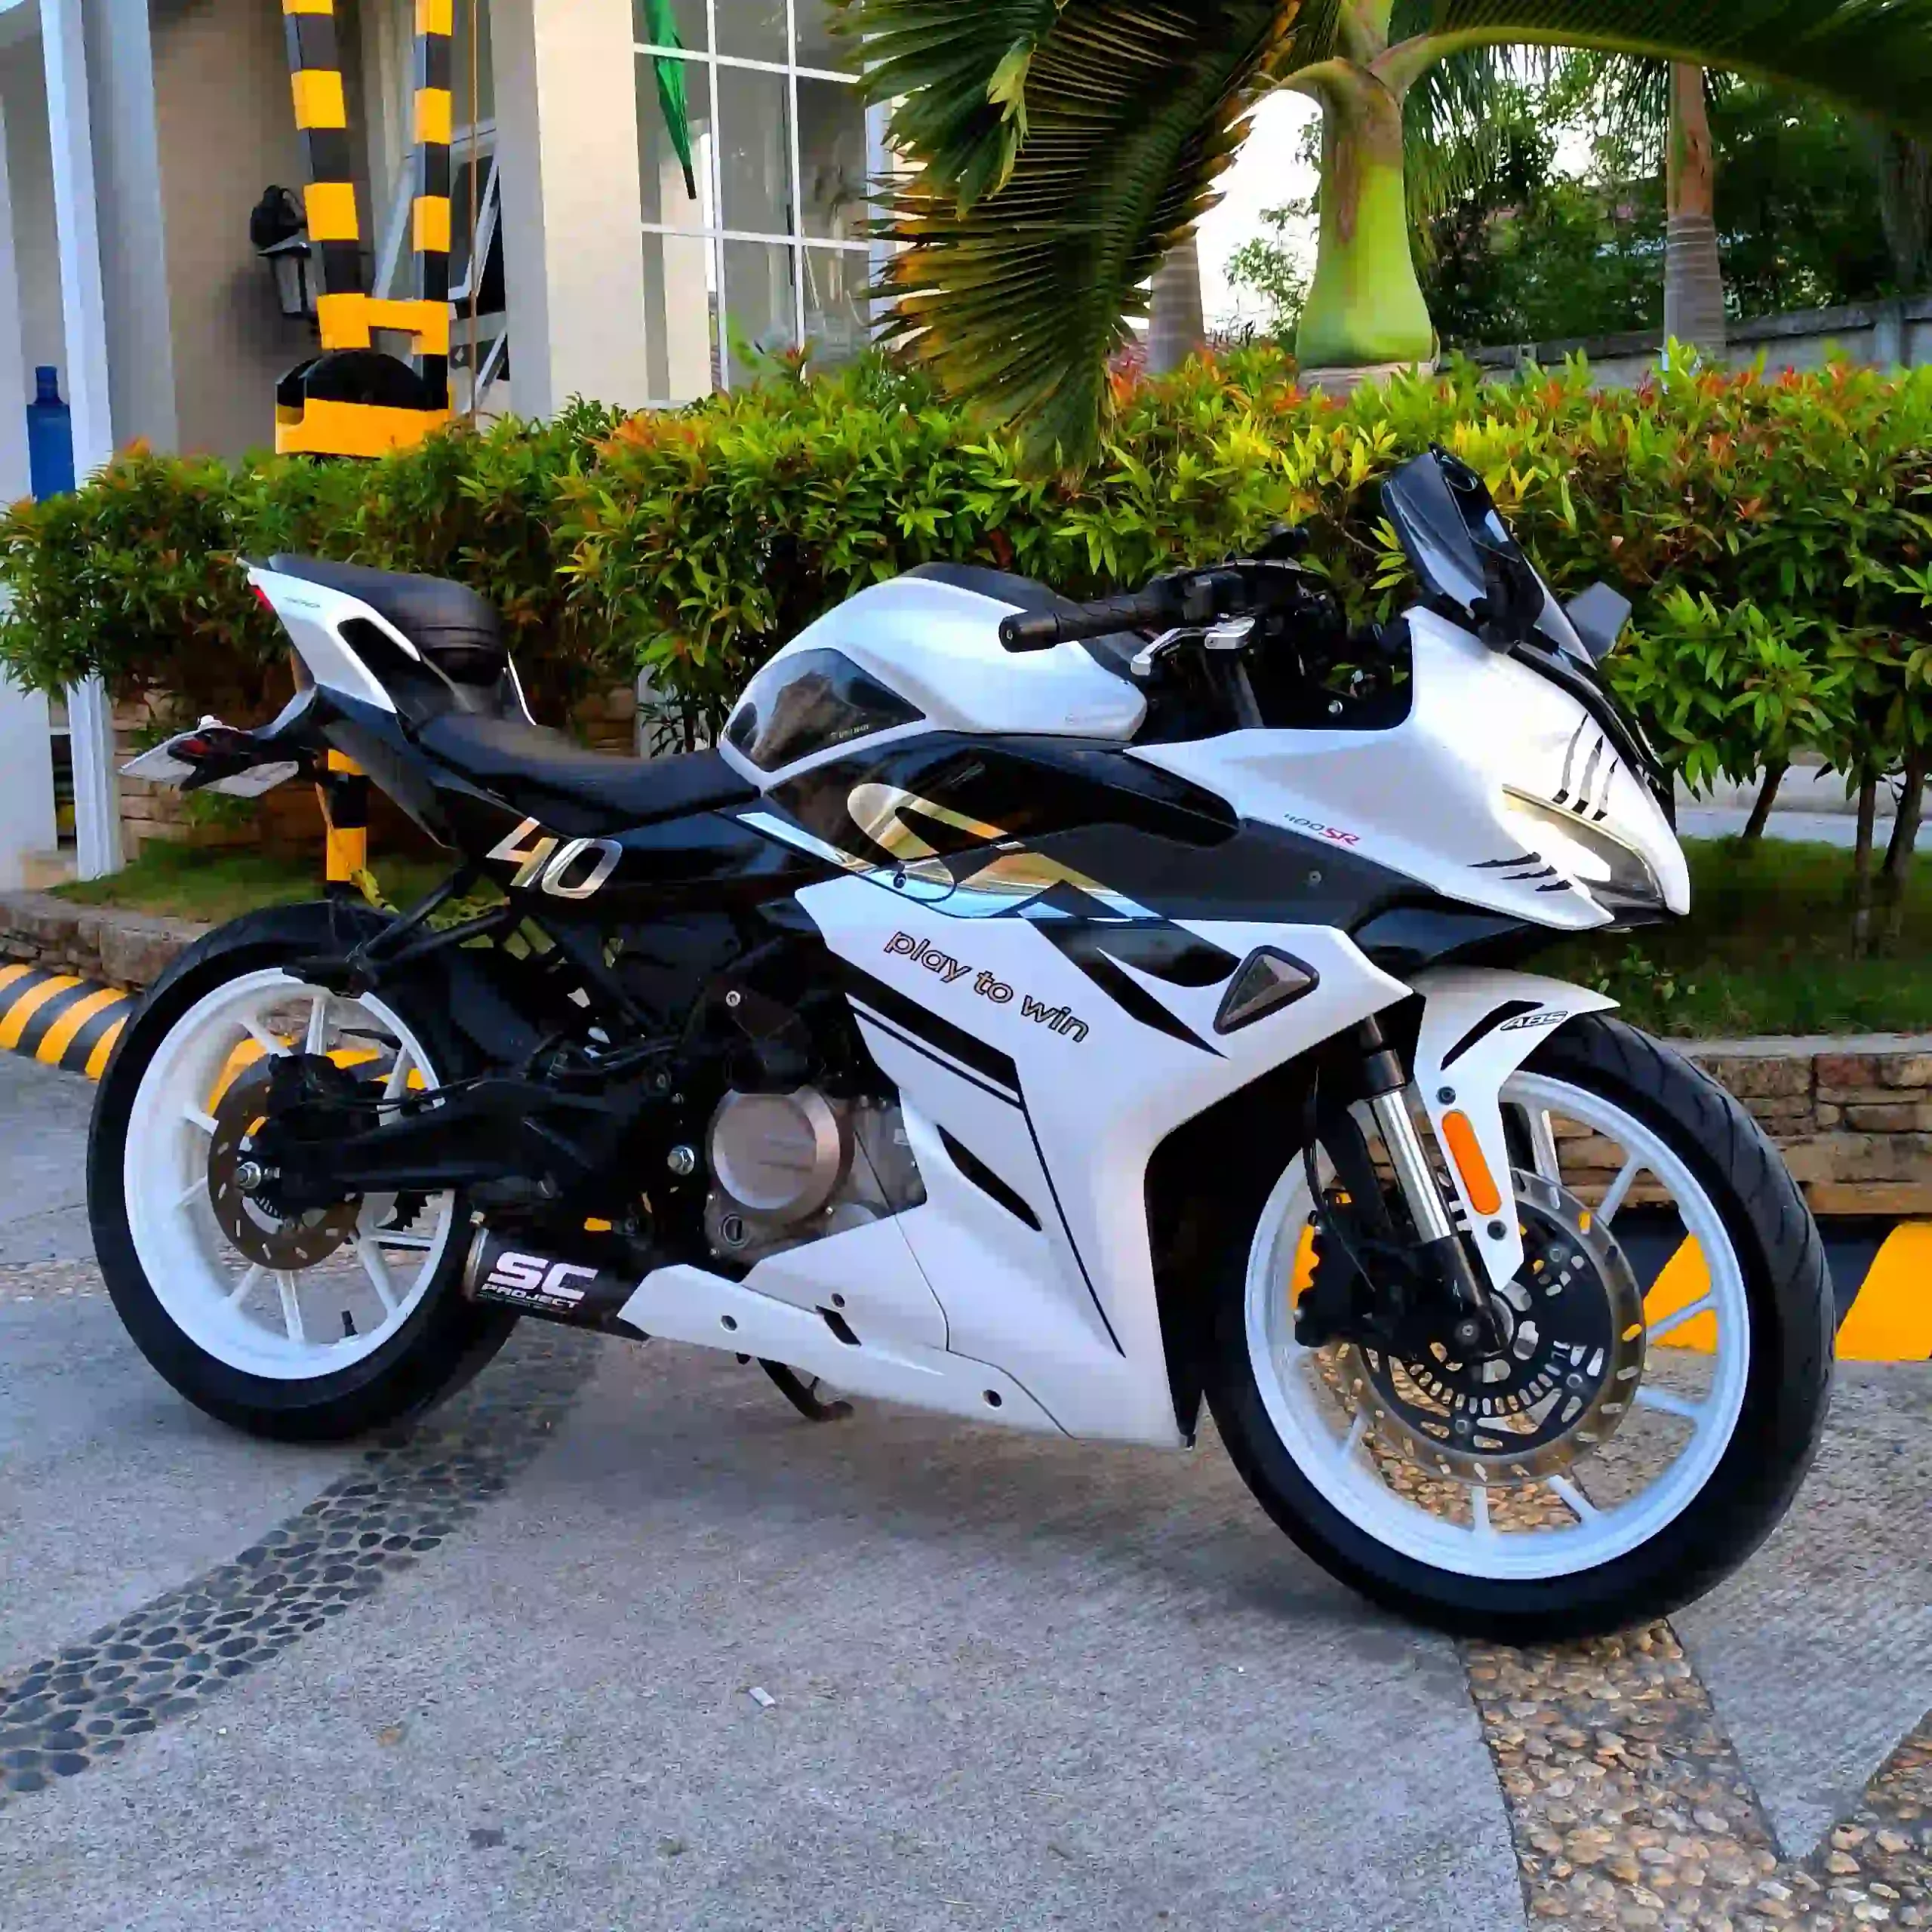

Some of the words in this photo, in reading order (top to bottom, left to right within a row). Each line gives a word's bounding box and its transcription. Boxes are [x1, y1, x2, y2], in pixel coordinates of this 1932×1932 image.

[486, 817, 623, 899] 40
[884, 931, 972, 983] play
[974, 971, 1014, 1003] to
[1020, 995, 1090, 1043] win
[1500, 1011, 1568, 1031] ABS
[481, 1283, 580, 1308] PROJECT
[487, 1251, 599, 1300] SC
